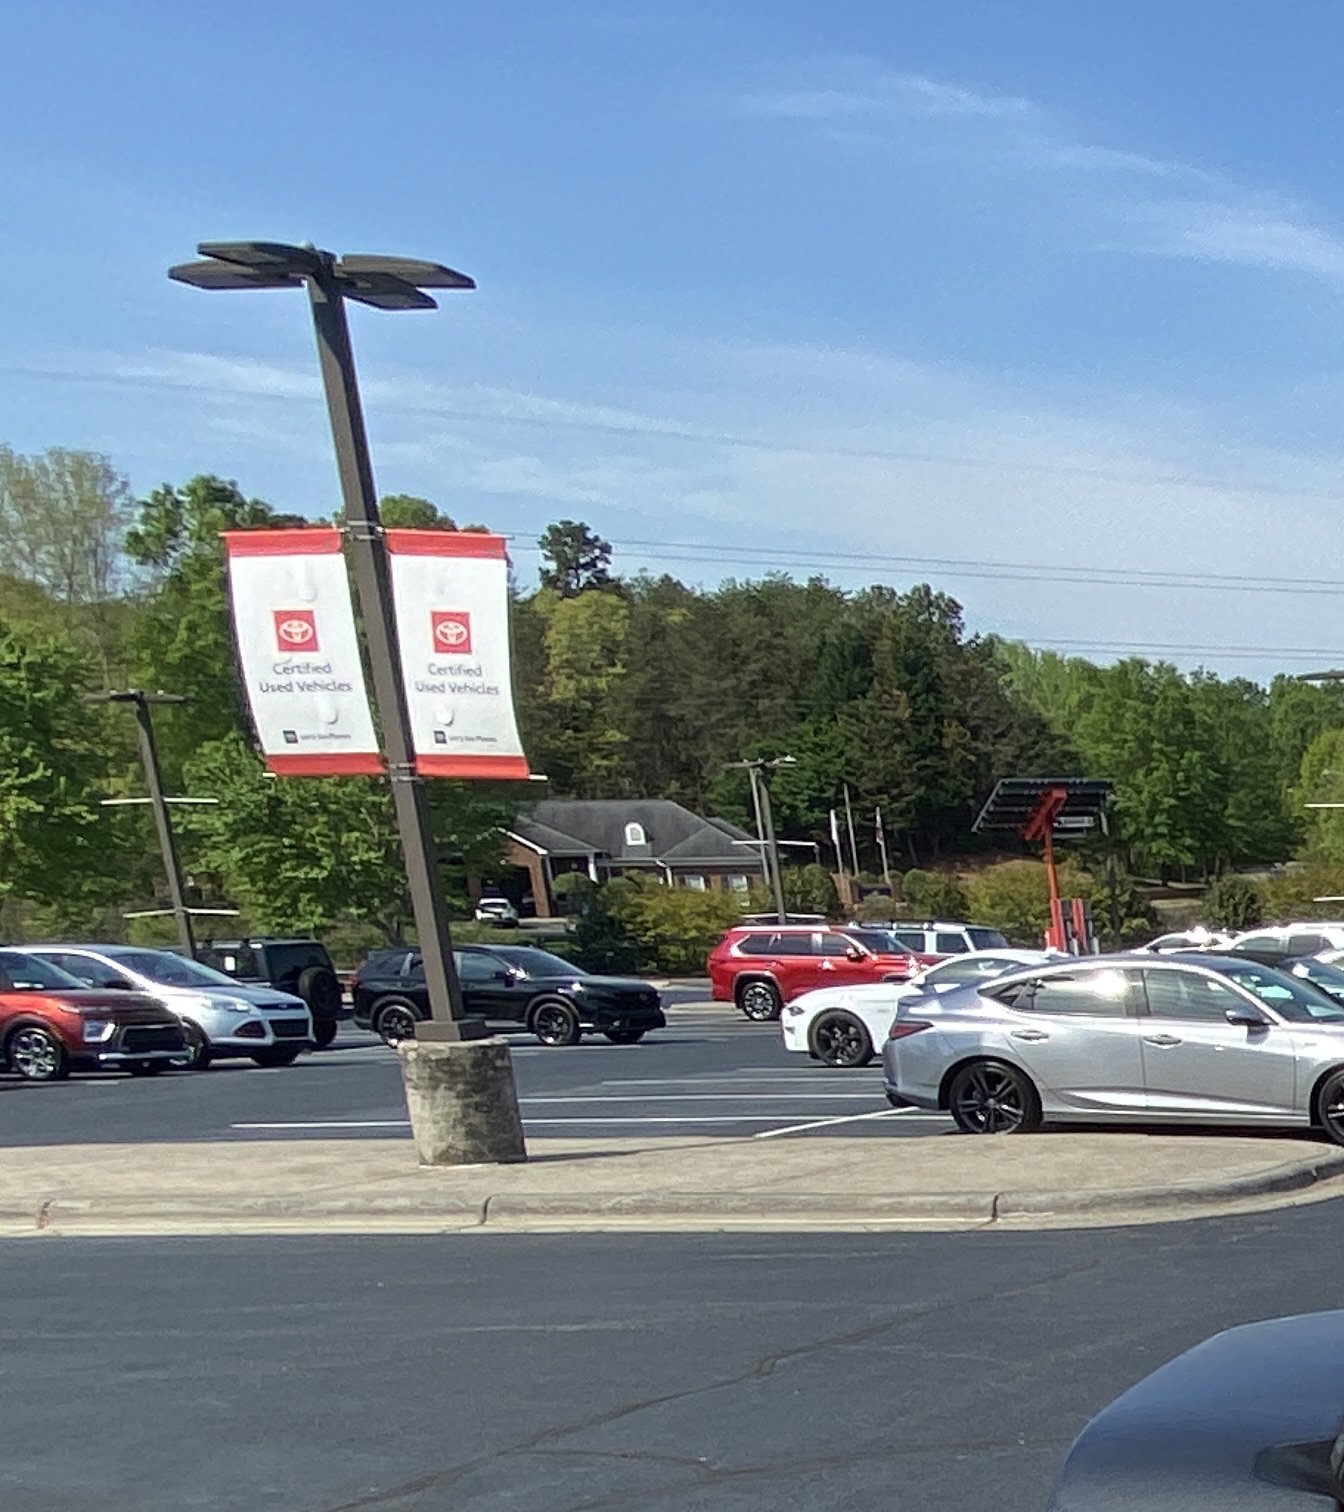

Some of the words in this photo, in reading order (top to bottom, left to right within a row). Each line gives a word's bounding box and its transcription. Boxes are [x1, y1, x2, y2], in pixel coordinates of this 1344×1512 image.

[258, 681, 294, 693] Used
[296, 680, 353, 692] Vehicles
[448, 682, 500, 696] Vehicles
